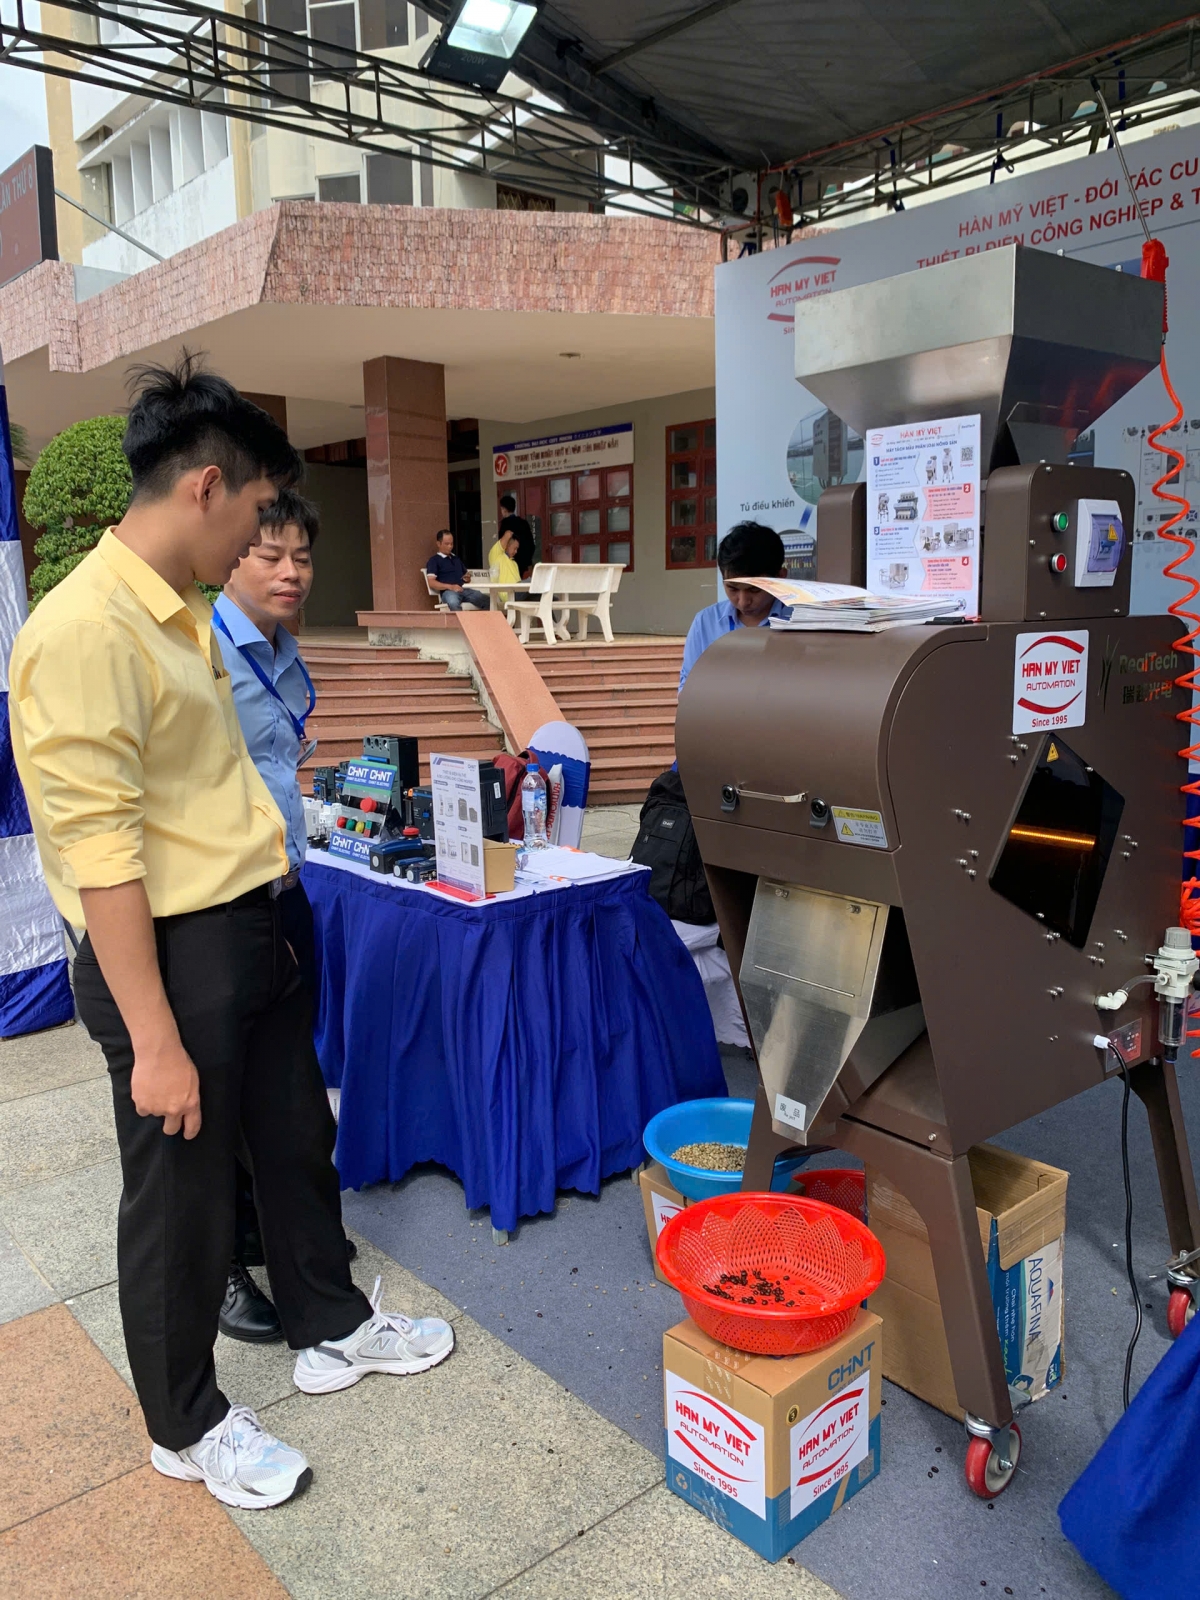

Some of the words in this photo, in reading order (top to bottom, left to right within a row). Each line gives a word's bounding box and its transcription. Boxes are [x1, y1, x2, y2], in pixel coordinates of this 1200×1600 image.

[460, 53, 488, 66] 200W
[27, 163, 33, 190] 8
[958, 215, 993, 238] HÀN
[998, 203, 1024, 227] MỸ
[1029, 193, 1069, 219] VIỆT
[1085, 178, 1119, 203] ĐỐI
[1170, 157, 1200, 180] CU
[1030, 218, 1083, 246] CÔNG
[1089, 197, 1163, 232] NGHIỆP
[1169, 193, 1184, 211] &
[1191, 187, 1200, 206] T
[770, 282, 792, 298] HAN
[795, 276, 810, 291] MY
[814, 269, 837, 287] VIET
[783, 326, 795, 335] Sin
[900, 429, 914, 439] HÀN
[928, 426, 942, 436] VIỆT
[740, 503, 750, 512] Tủ
[1022, 661, 1042, 678] HAN
[1045, 661, 1058, 676] MY
[1062, 659, 1081, 675] VIET
[1120, 650, 1178, 673] RealTech
[1026, 680, 1076, 691] AUTOMATION
[1031, 717, 1050, 728] Since
[1051, 715, 1068, 726] 1995
[353, 841, 372, 855] CHIN
[1027, 1257, 1044, 1349] AQUAFINA
[675, 1399, 699, 1425] HAN
[702, 1418, 720, 1437] MY
[725, 1430, 751, 1457] VIET
[799, 1434, 820, 1461] HAN
[822, 1419, 836, 1442] MY
[839, 1402, 860, 1428] VIET
[680, 1421, 744, 1467] AUTOMATION
[802, 1424, 854, 1470] AUTOMATION
[693, 1462, 716, 1483] Since
[717, 1477, 738, 1498] 1995
[813, 1479, 832, 1498] Since
[833, 1462, 849, 1482] 1995
